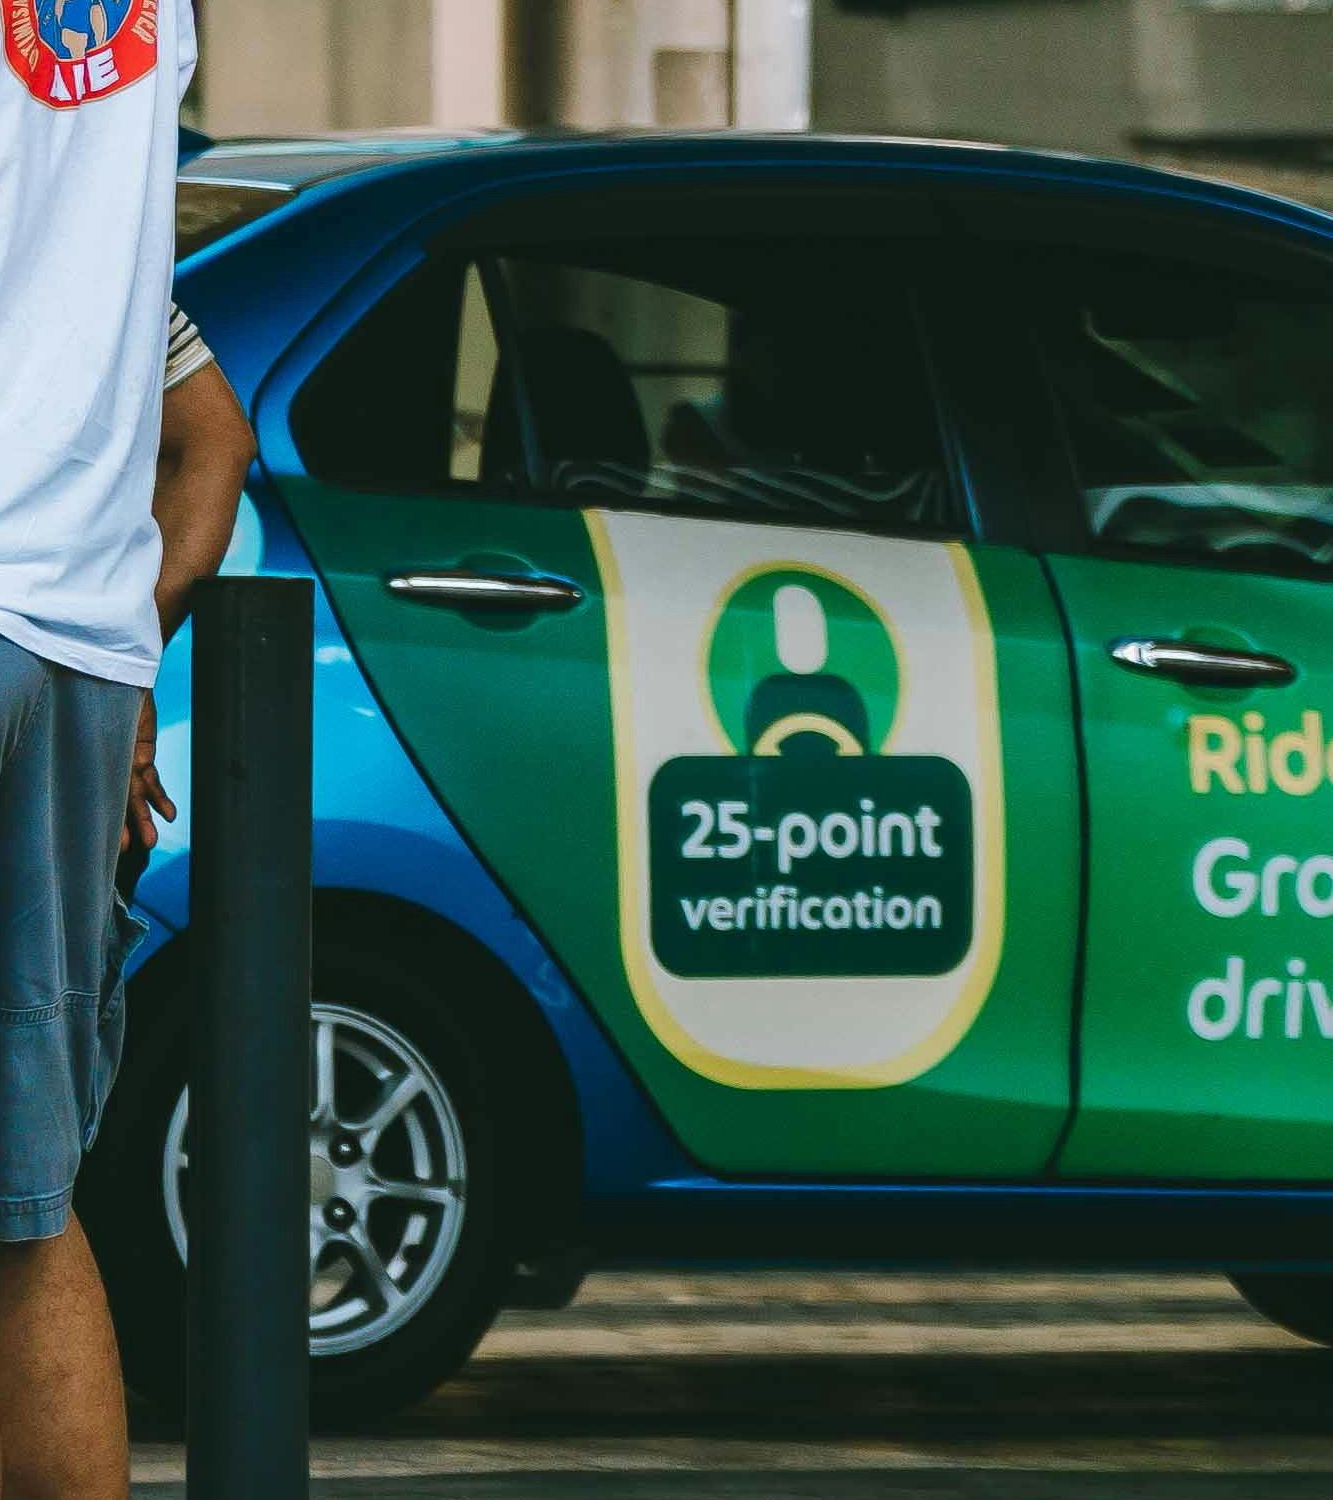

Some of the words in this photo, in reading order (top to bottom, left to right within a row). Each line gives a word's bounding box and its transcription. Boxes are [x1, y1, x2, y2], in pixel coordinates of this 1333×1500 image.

[1188, 710, 1333, 796] Rid
[681, 798, 943, 874] 25-point
[680, 886, 942, 931] verification
